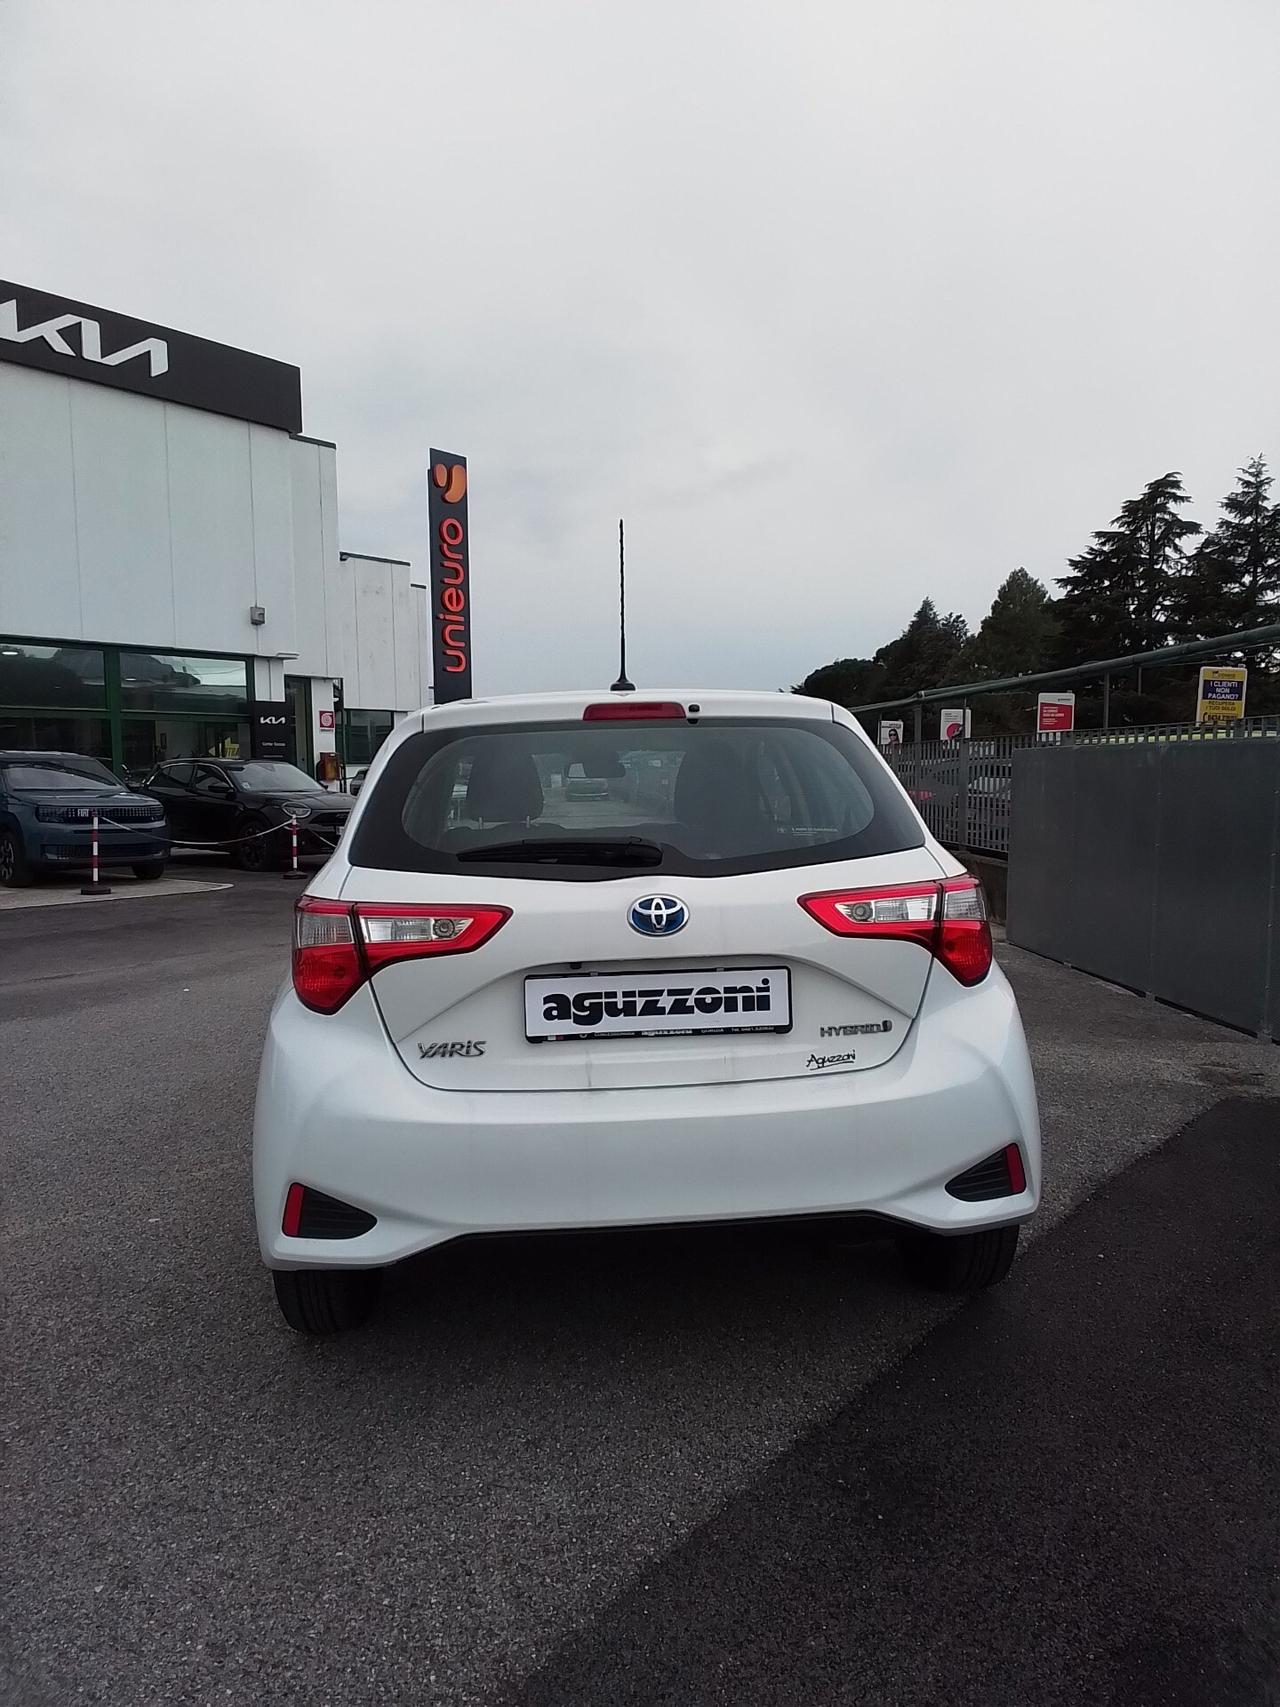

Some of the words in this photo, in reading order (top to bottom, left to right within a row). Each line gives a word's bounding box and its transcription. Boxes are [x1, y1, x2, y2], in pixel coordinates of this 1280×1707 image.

[437, 517, 466, 673] unieuro
[1207, 692, 1239, 700] PAGANO?
[542, 977, 771, 1026] aguzzoni
[820, 1023, 882, 1037] HYBRID
[806, 1049, 856, 1070] Aguzzoni
